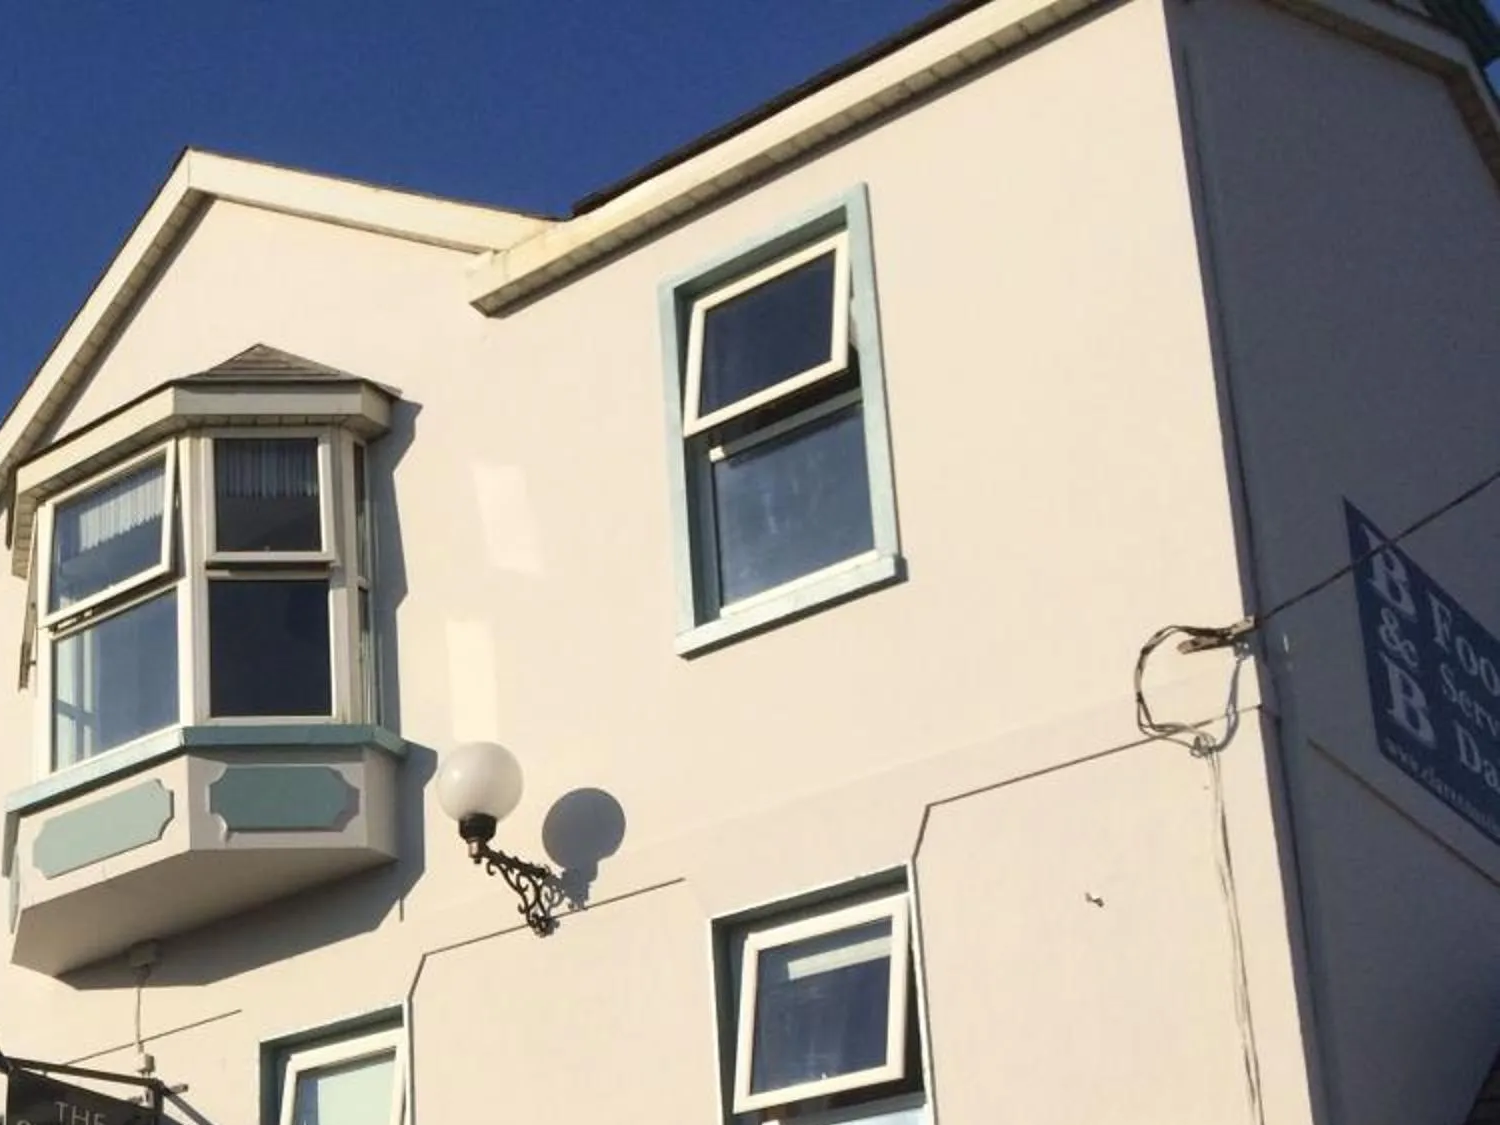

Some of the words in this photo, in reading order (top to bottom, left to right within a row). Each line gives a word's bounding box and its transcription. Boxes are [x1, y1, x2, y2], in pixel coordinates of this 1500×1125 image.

[1360, 523, 1417, 619] B
[1379, 651, 1436, 748] B
[1452, 718, 1500, 795] Da
